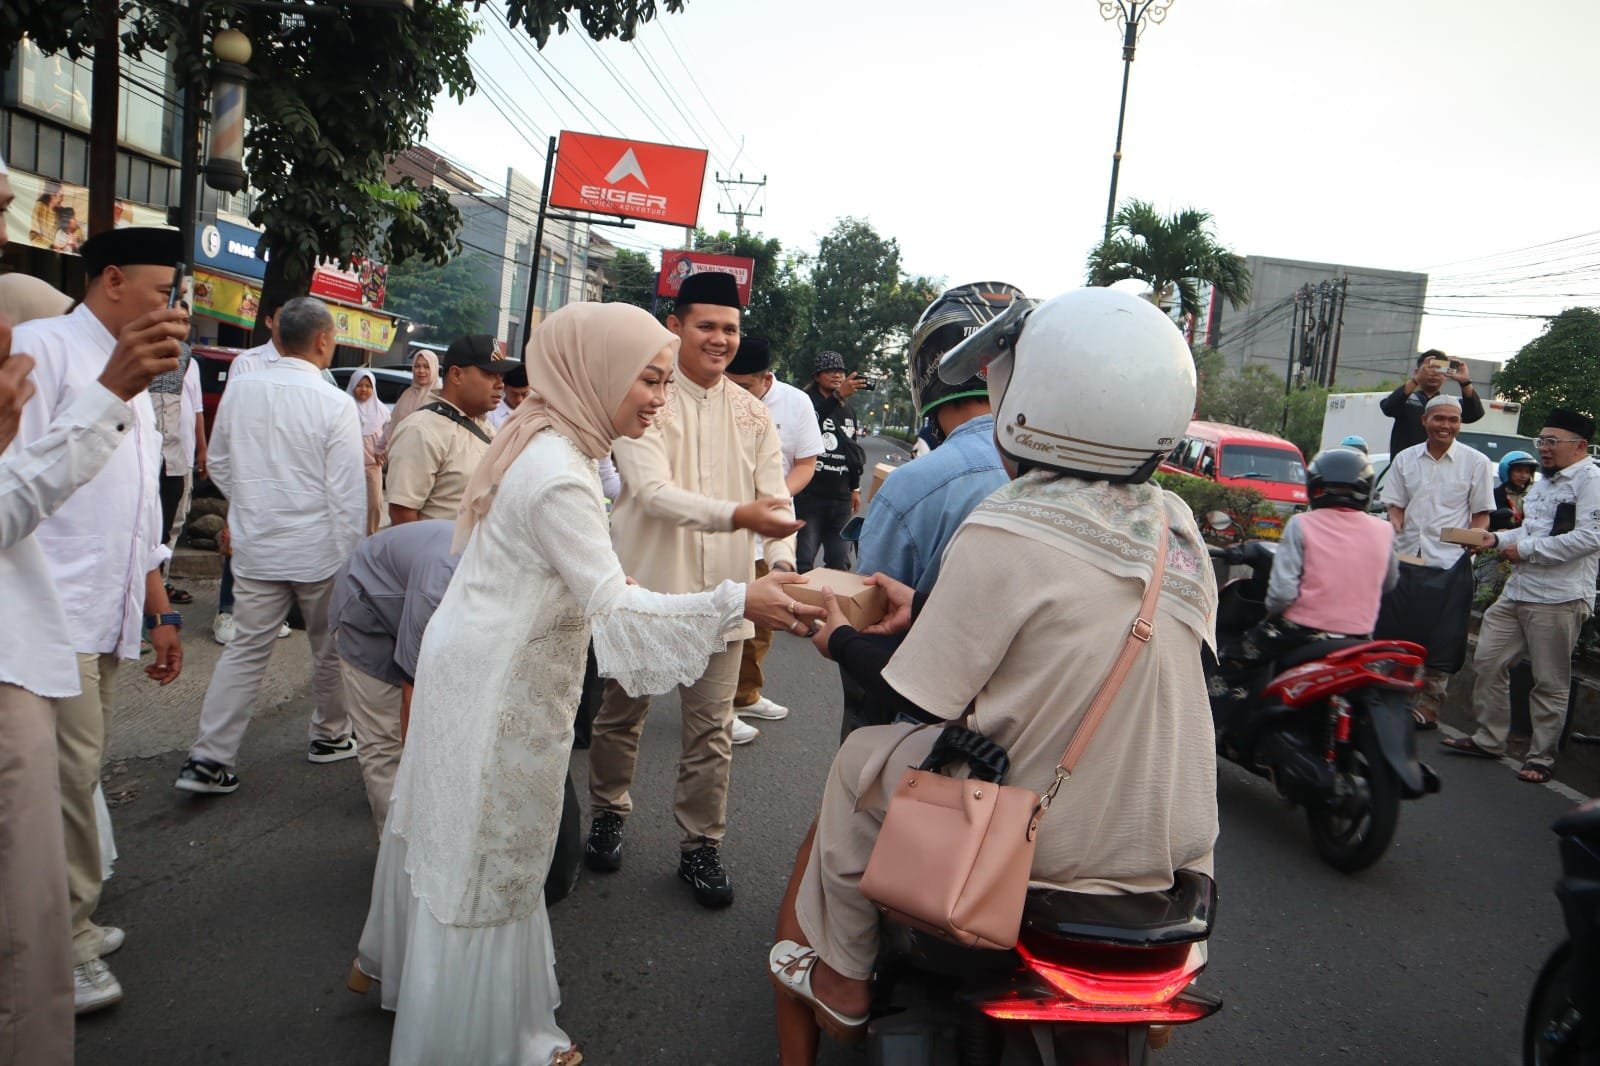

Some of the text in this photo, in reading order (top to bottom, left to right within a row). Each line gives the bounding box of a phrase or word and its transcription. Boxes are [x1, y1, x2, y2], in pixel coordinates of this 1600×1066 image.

[579, 198, 666, 216] TROPICAL ADVENTURE
[580, 185, 667, 209] EIGER
[1014, 433, 1055, 453] Classic
